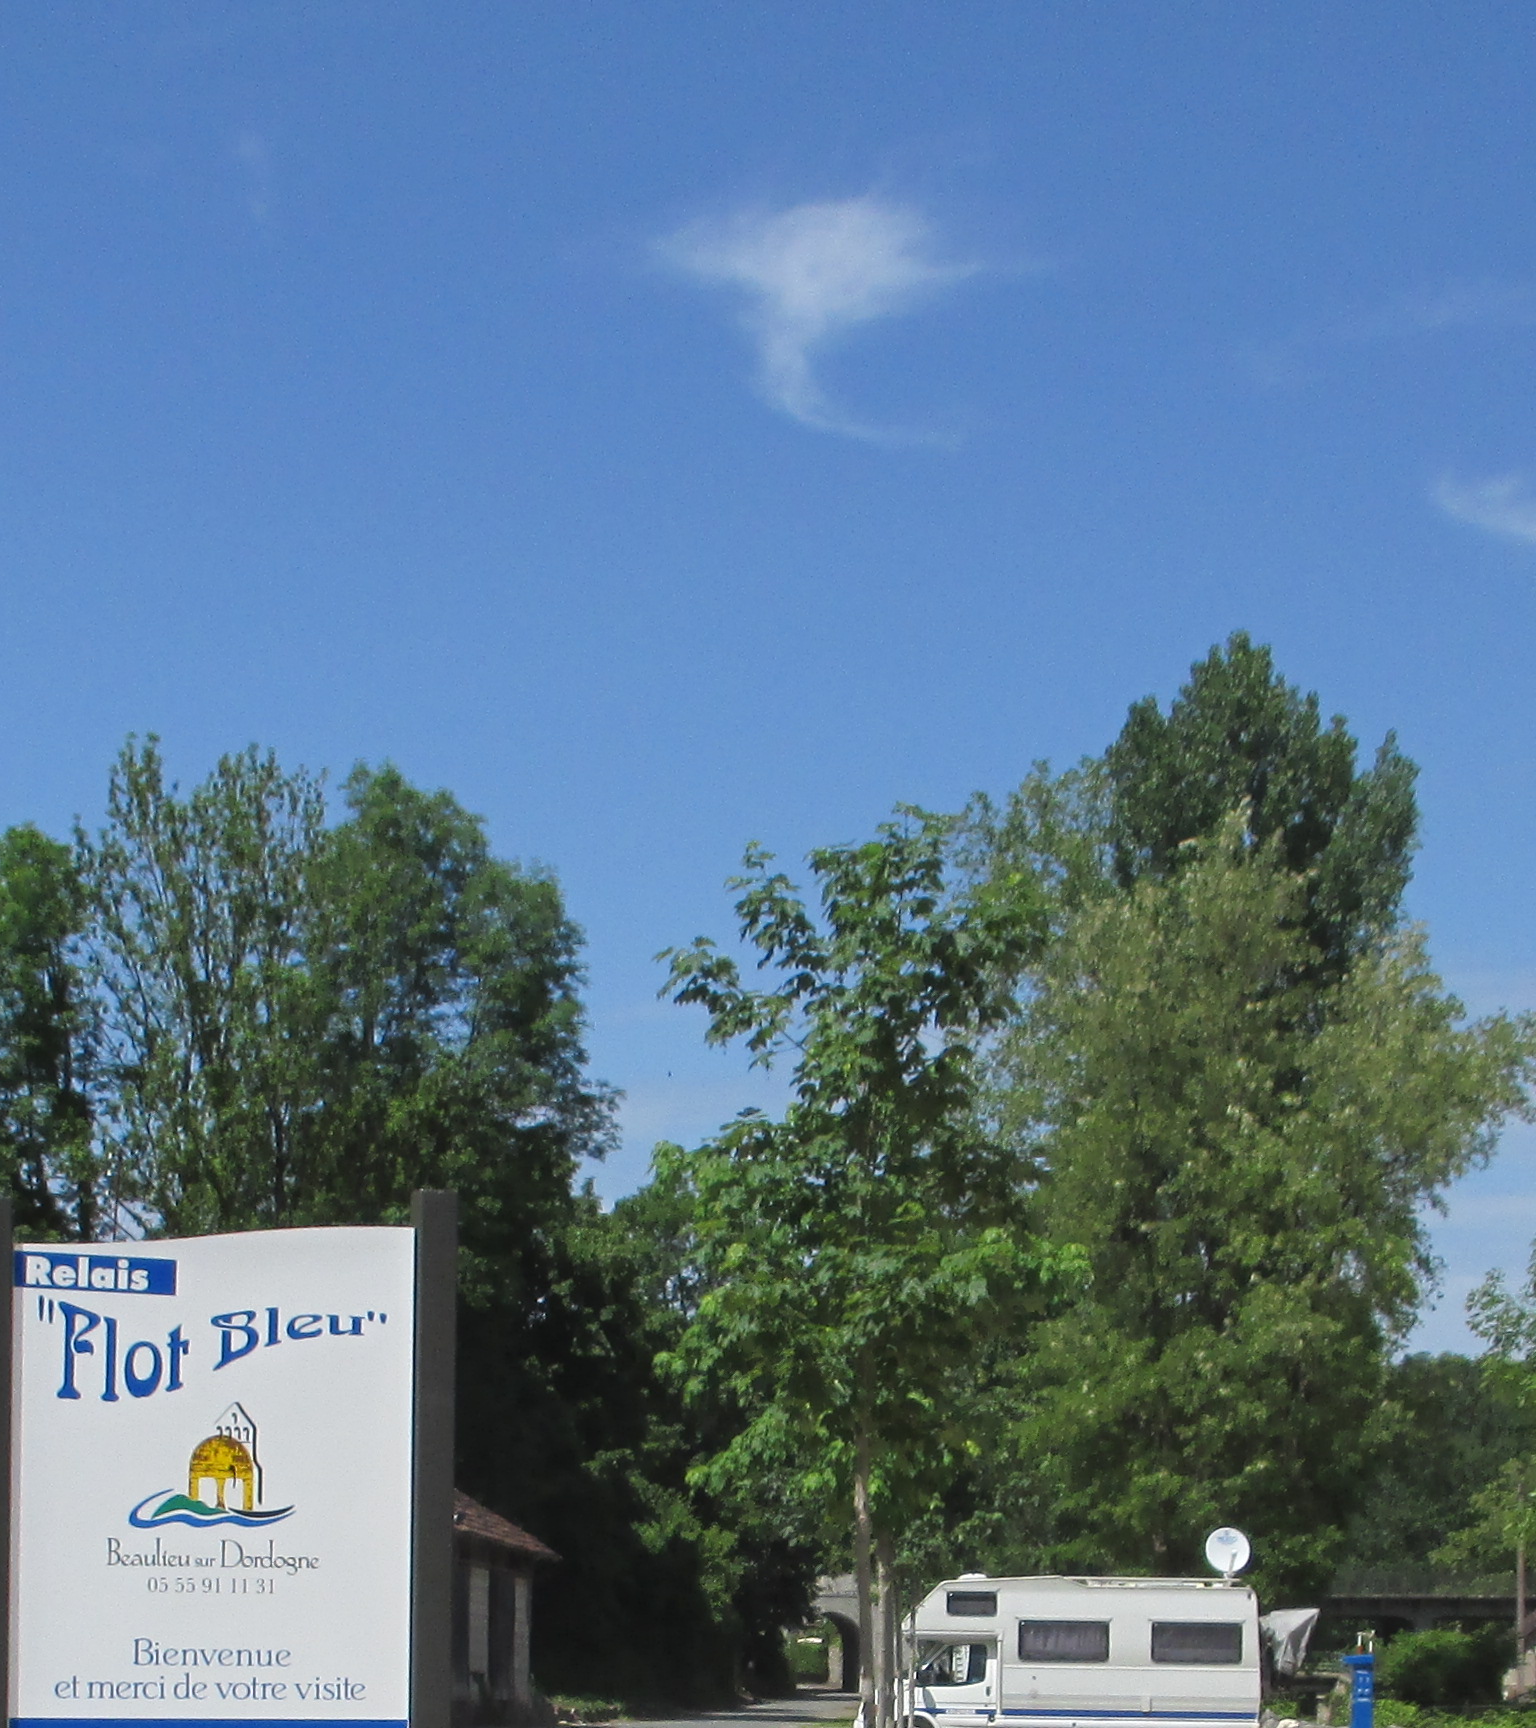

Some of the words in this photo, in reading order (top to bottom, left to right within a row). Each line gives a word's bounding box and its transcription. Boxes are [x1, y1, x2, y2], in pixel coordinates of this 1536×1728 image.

[25, 1254, 149, 1292] Relais
[106, 1537, 190, 1568] Beaulieu
[194, 1557, 216, 1568] sur
[220, 1539, 321, 1576] Dordogne
[147, 1577, 168, 1593] 05
[175, 1577, 196, 1594] 55
[202, 1577, 221, 1594] 91
[231, 1577, 248, 1594] 11
[255, 1578, 276, 1595] 31
[132, 1637, 292, 1668] Bienvenue
[54, 1675, 79, 1700] et
[87, 1675, 166, 1700] merci
[173, 1672, 208, 1701] de
[214, 1676, 287, 1701] votre
[295, 1676, 367, 1701] visite
